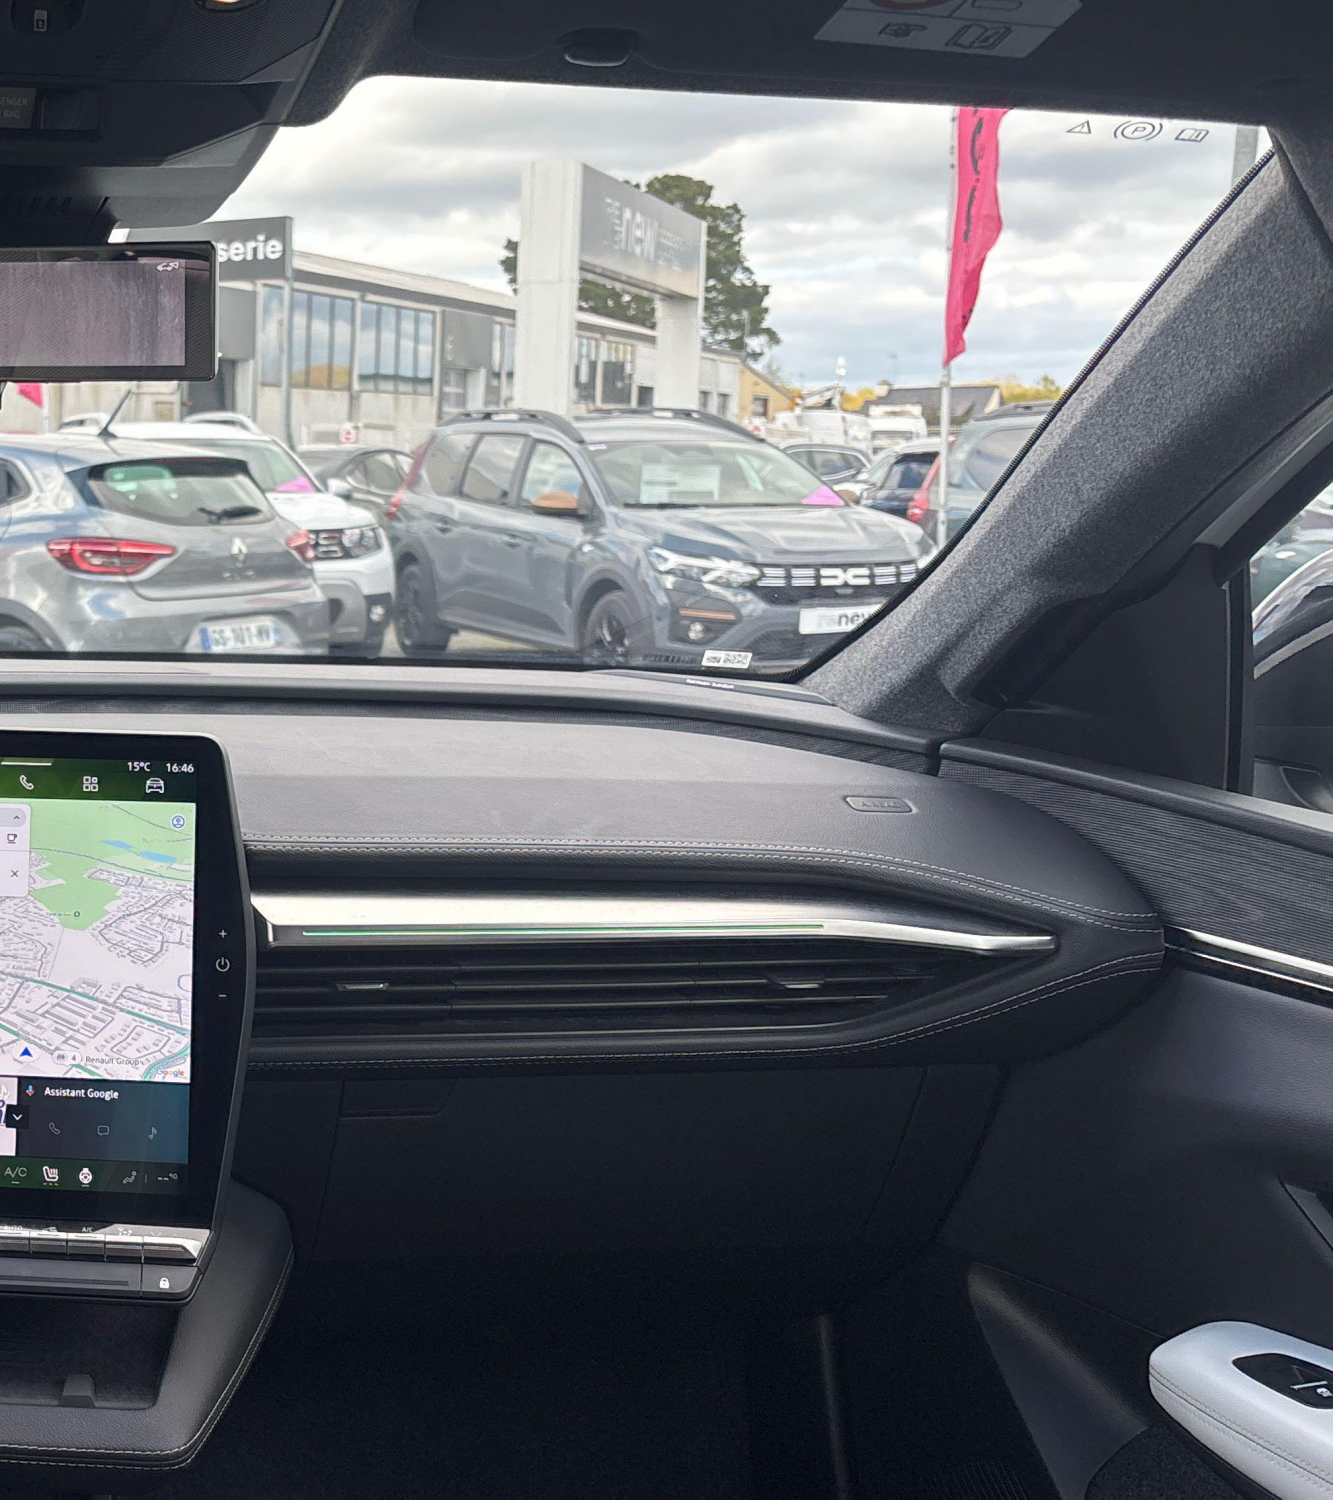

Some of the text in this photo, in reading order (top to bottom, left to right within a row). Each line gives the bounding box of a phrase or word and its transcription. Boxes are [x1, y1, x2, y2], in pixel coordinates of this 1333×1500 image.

[166, 763, 195, 774] 16:46
[85, 1056, 114, 1064] Renault
[115, 1058, 140, 1067] Group
[155, 1066, 185, 1078] Google
[44, 1086, 119, 1101] Assistant Google
[3, 1167, 28, 1178] A/C
